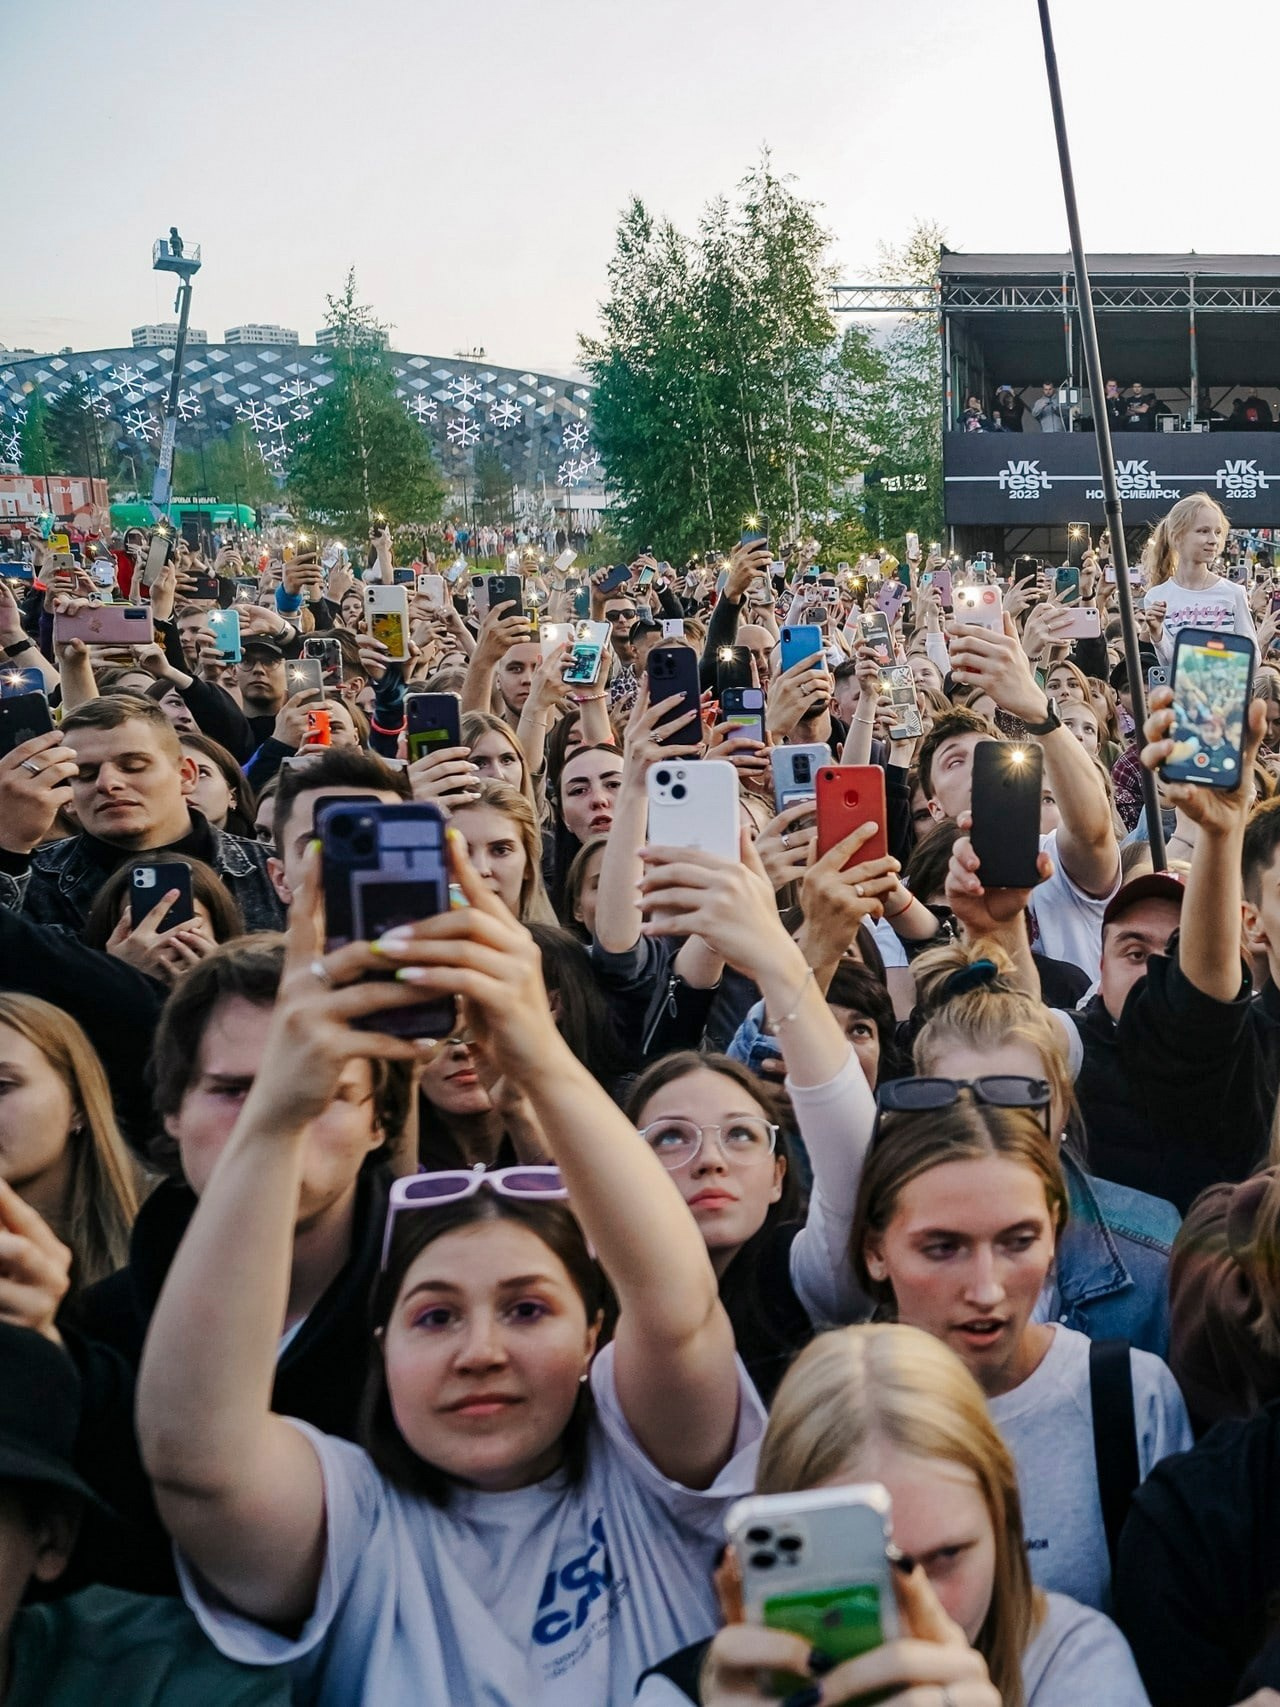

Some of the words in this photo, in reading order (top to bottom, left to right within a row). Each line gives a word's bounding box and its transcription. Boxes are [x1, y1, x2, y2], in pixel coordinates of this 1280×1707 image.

[1007, 460, 1040, 475] VK
[1116, 460, 1149, 474] VK
[1224, 459, 1257, 474] VK
[999, 469, 1052, 490] fest
[1216, 469, 1269, 489] fest
[1009, 489, 1040, 499] 2023
[1225, 489, 1257, 499] 2023
